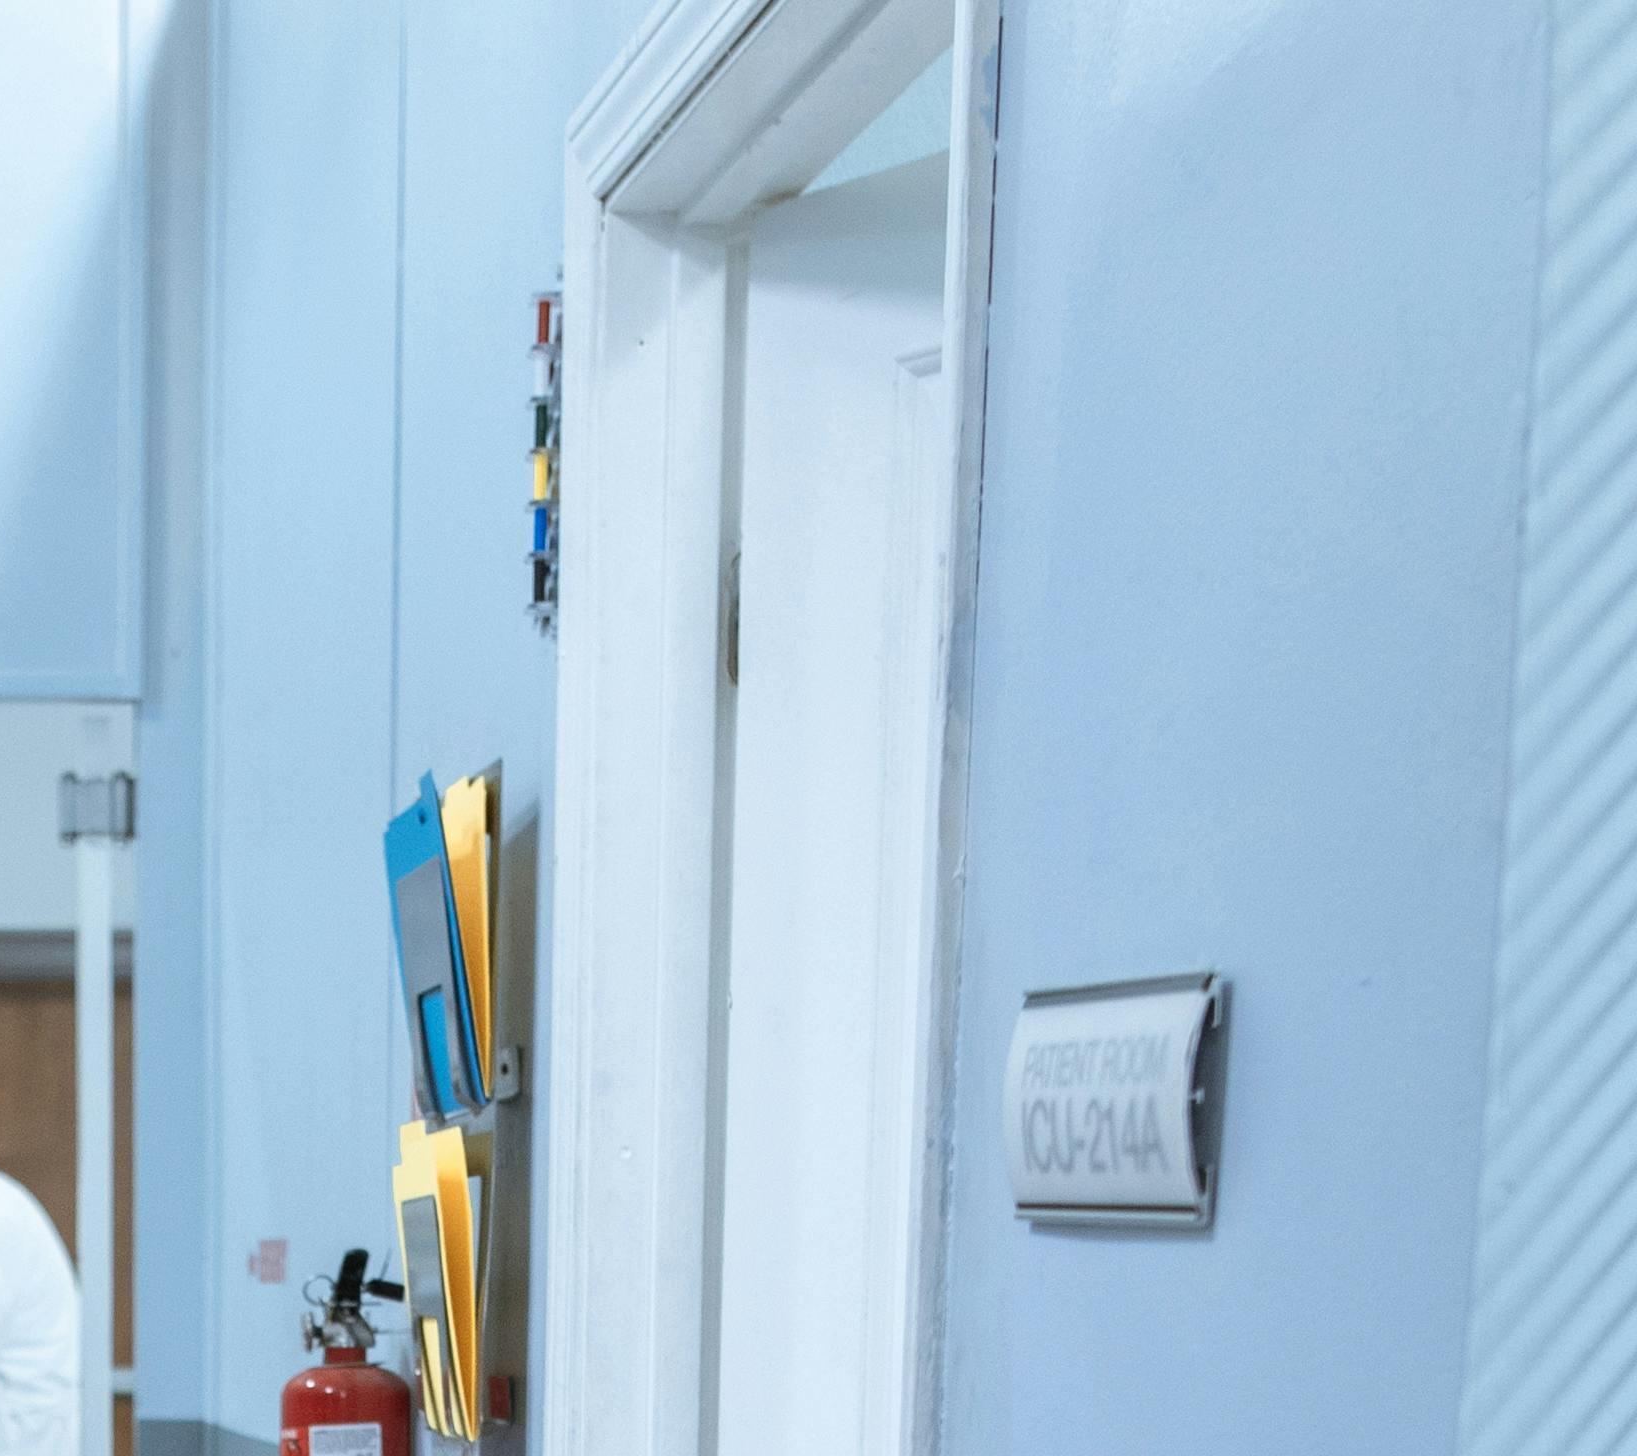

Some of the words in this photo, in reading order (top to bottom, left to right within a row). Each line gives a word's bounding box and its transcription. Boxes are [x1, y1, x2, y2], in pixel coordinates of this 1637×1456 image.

[1022, 1039, 1101, 1087] PATIENT
[1100, 1034, 1171, 1084] ROOM
[1021, 1095, 1171, 1174] ICU-214A
